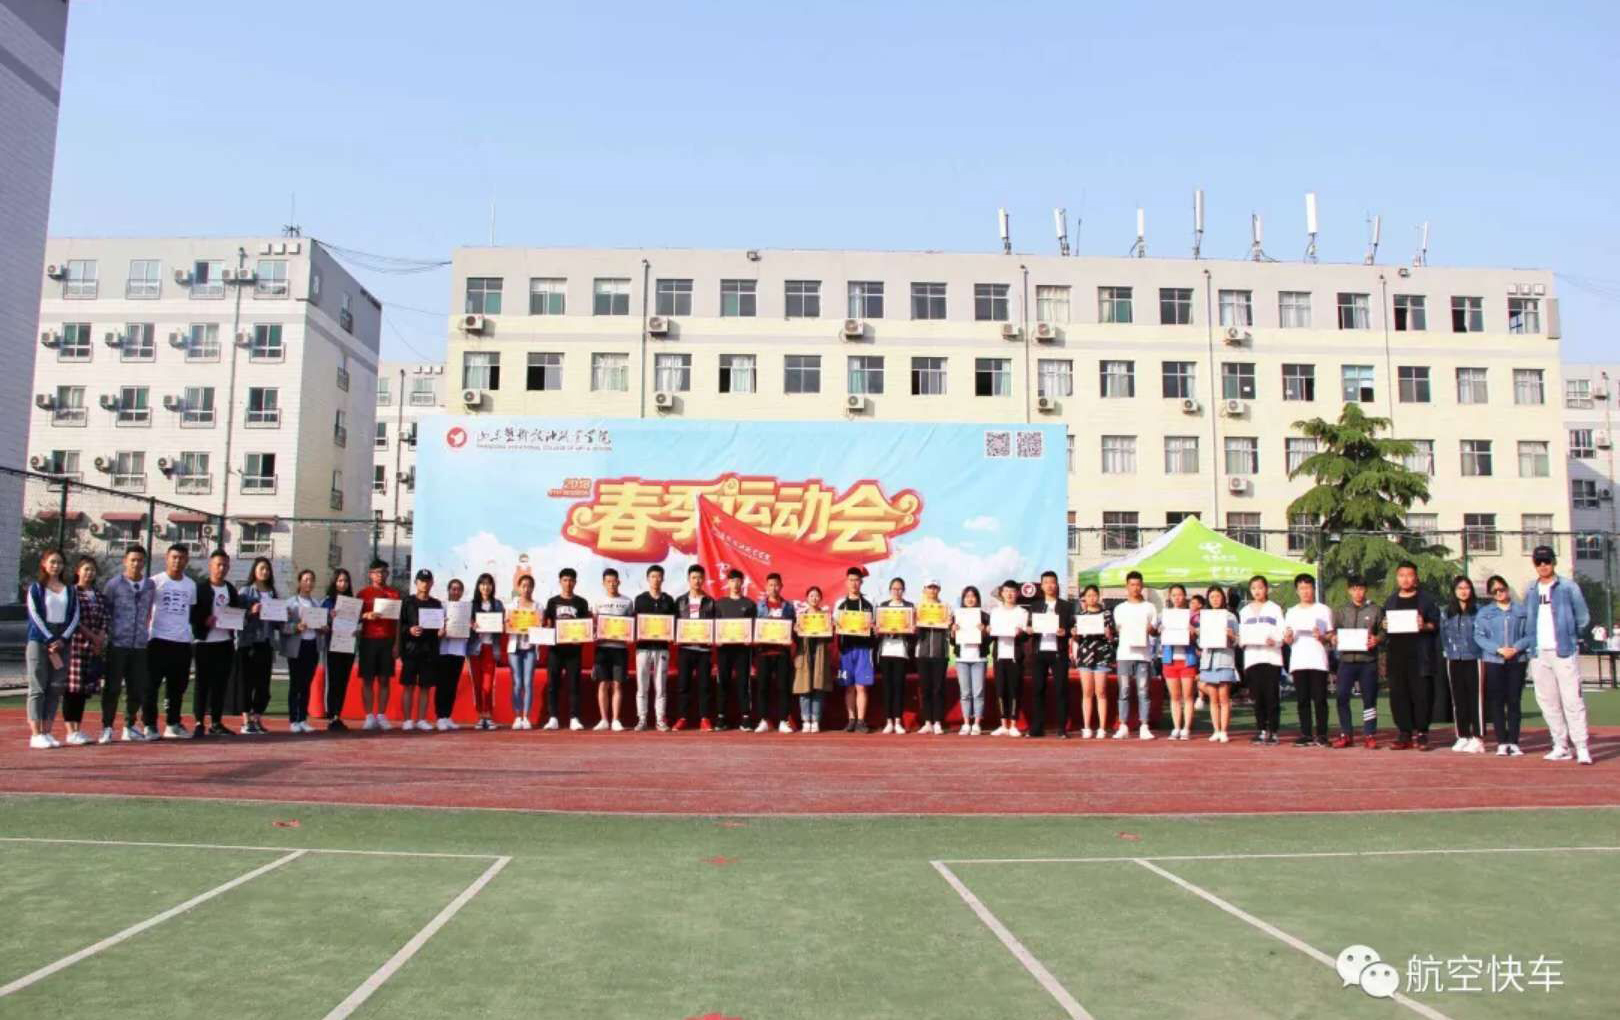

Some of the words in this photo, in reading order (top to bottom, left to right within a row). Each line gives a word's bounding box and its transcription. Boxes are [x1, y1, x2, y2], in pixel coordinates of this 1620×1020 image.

[594, 477, 906, 555] 春季运动会
